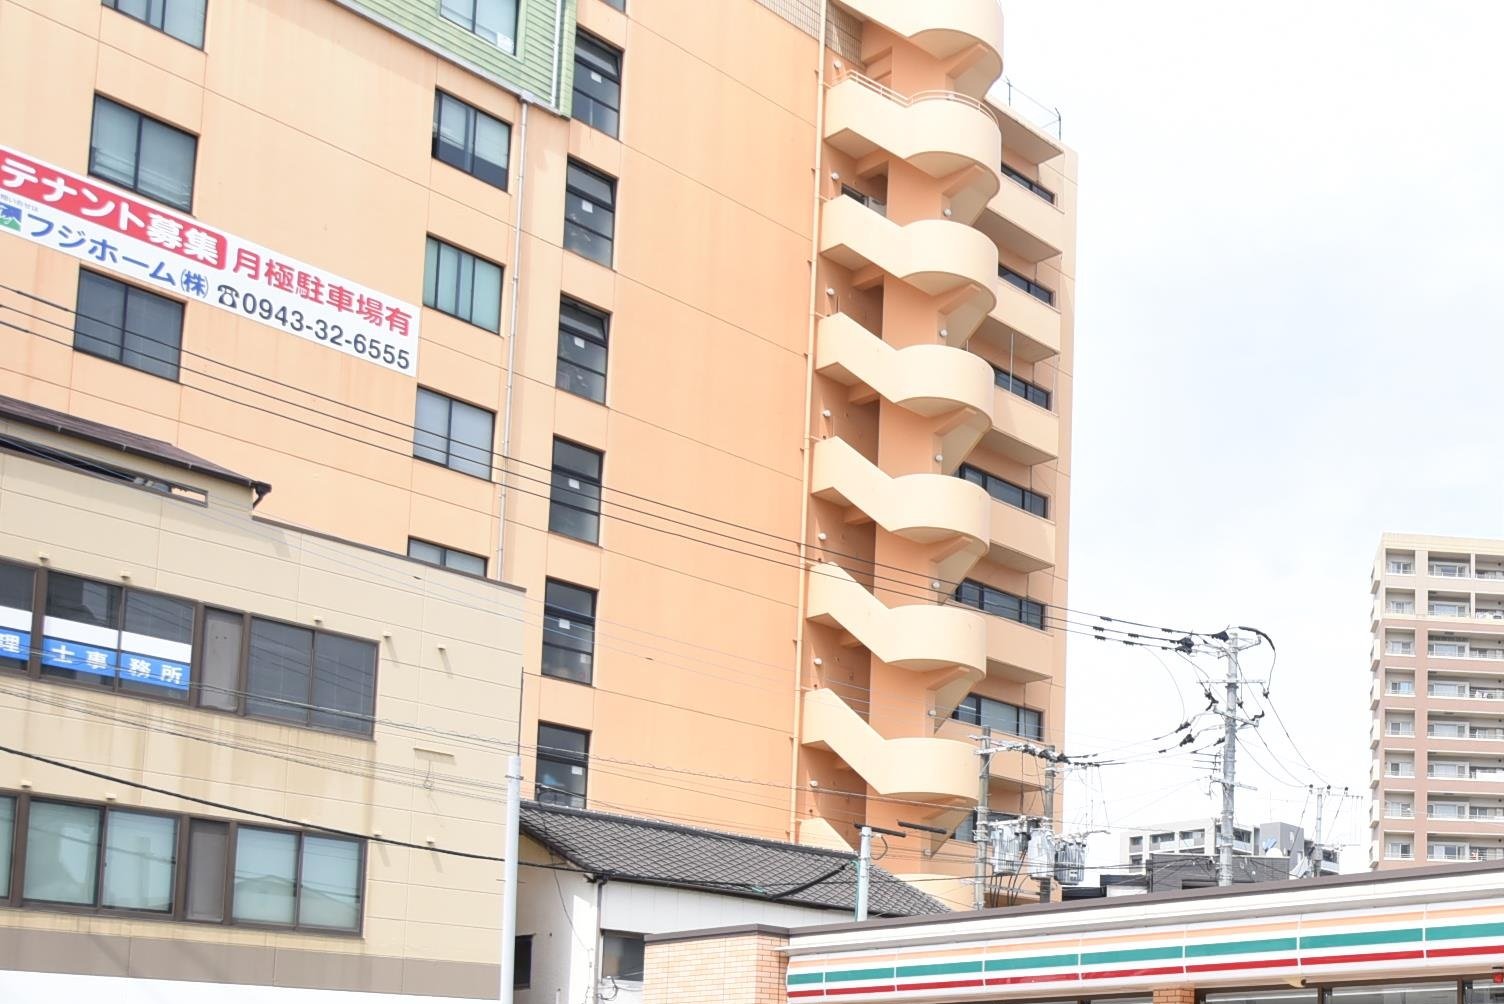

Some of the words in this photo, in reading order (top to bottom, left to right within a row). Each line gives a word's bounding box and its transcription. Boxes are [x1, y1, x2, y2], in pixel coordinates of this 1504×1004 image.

[1, 158, 218, 265] テナント募集
[233, 247, 412, 337] 月極駐車場有
[242, 292, 410, 370] 0943-32-6555
